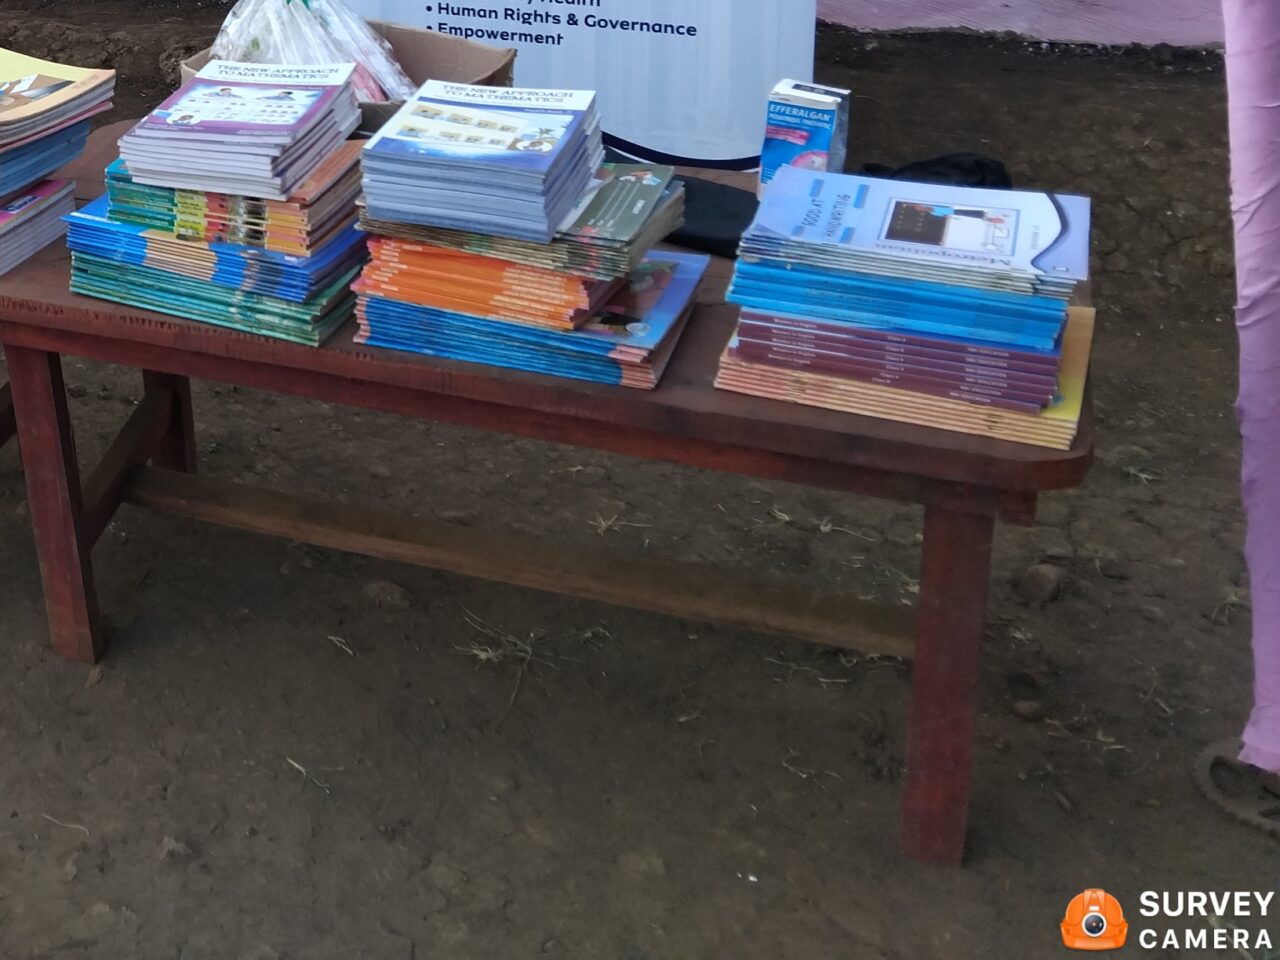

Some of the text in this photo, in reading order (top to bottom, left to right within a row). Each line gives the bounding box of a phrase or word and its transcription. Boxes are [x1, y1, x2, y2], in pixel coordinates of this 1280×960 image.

[438, 2, 697, 36] Human Rights & Governance
[438, 23, 563, 45] Empowerment
[463, 92, 564, 103] MATHEMATICS
[500, 90, 573, 98] APPROACH
[769, 104, 831, 122] EFFERALGAN
[802, 198, 825, 227] GOOD AT
[823, 194, 852, 238] HANDWRITING
[876, 243, 1011, 266] Metropolitan
